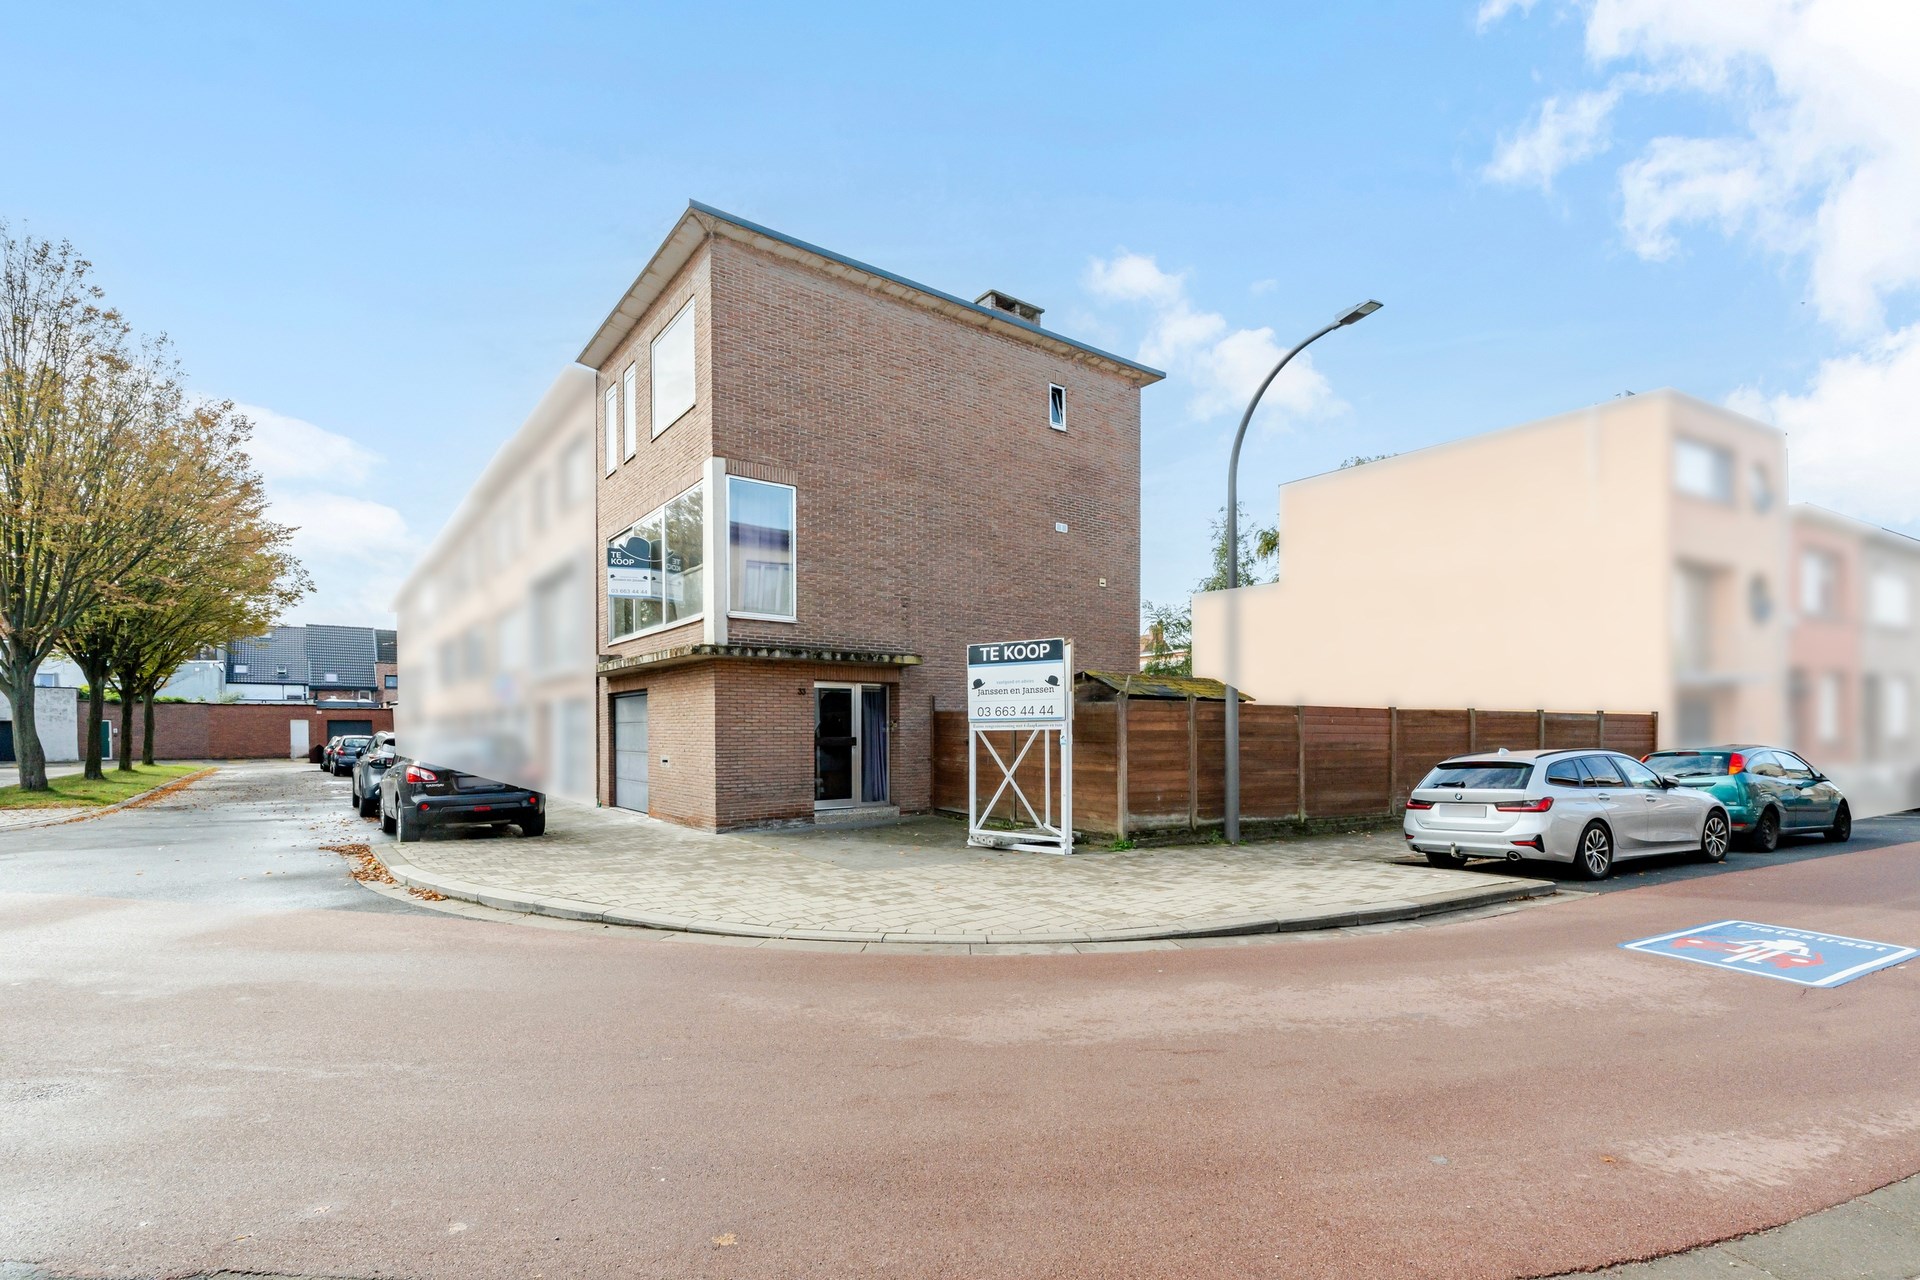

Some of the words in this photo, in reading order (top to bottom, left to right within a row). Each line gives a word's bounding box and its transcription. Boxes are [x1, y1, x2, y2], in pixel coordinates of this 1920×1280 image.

[979, 646, 999, 661] TE
[1004, 643, 1051, 660] KOOP
[797, 687, 806, 695] 33
[1010, 687, 1021, 695] en
[977, 706, 991, 717] 03
[995, 705, 1016, 717] 663
[1020, 705, 1035, 716] 44
[1039, 705, 1054, 716] 44
